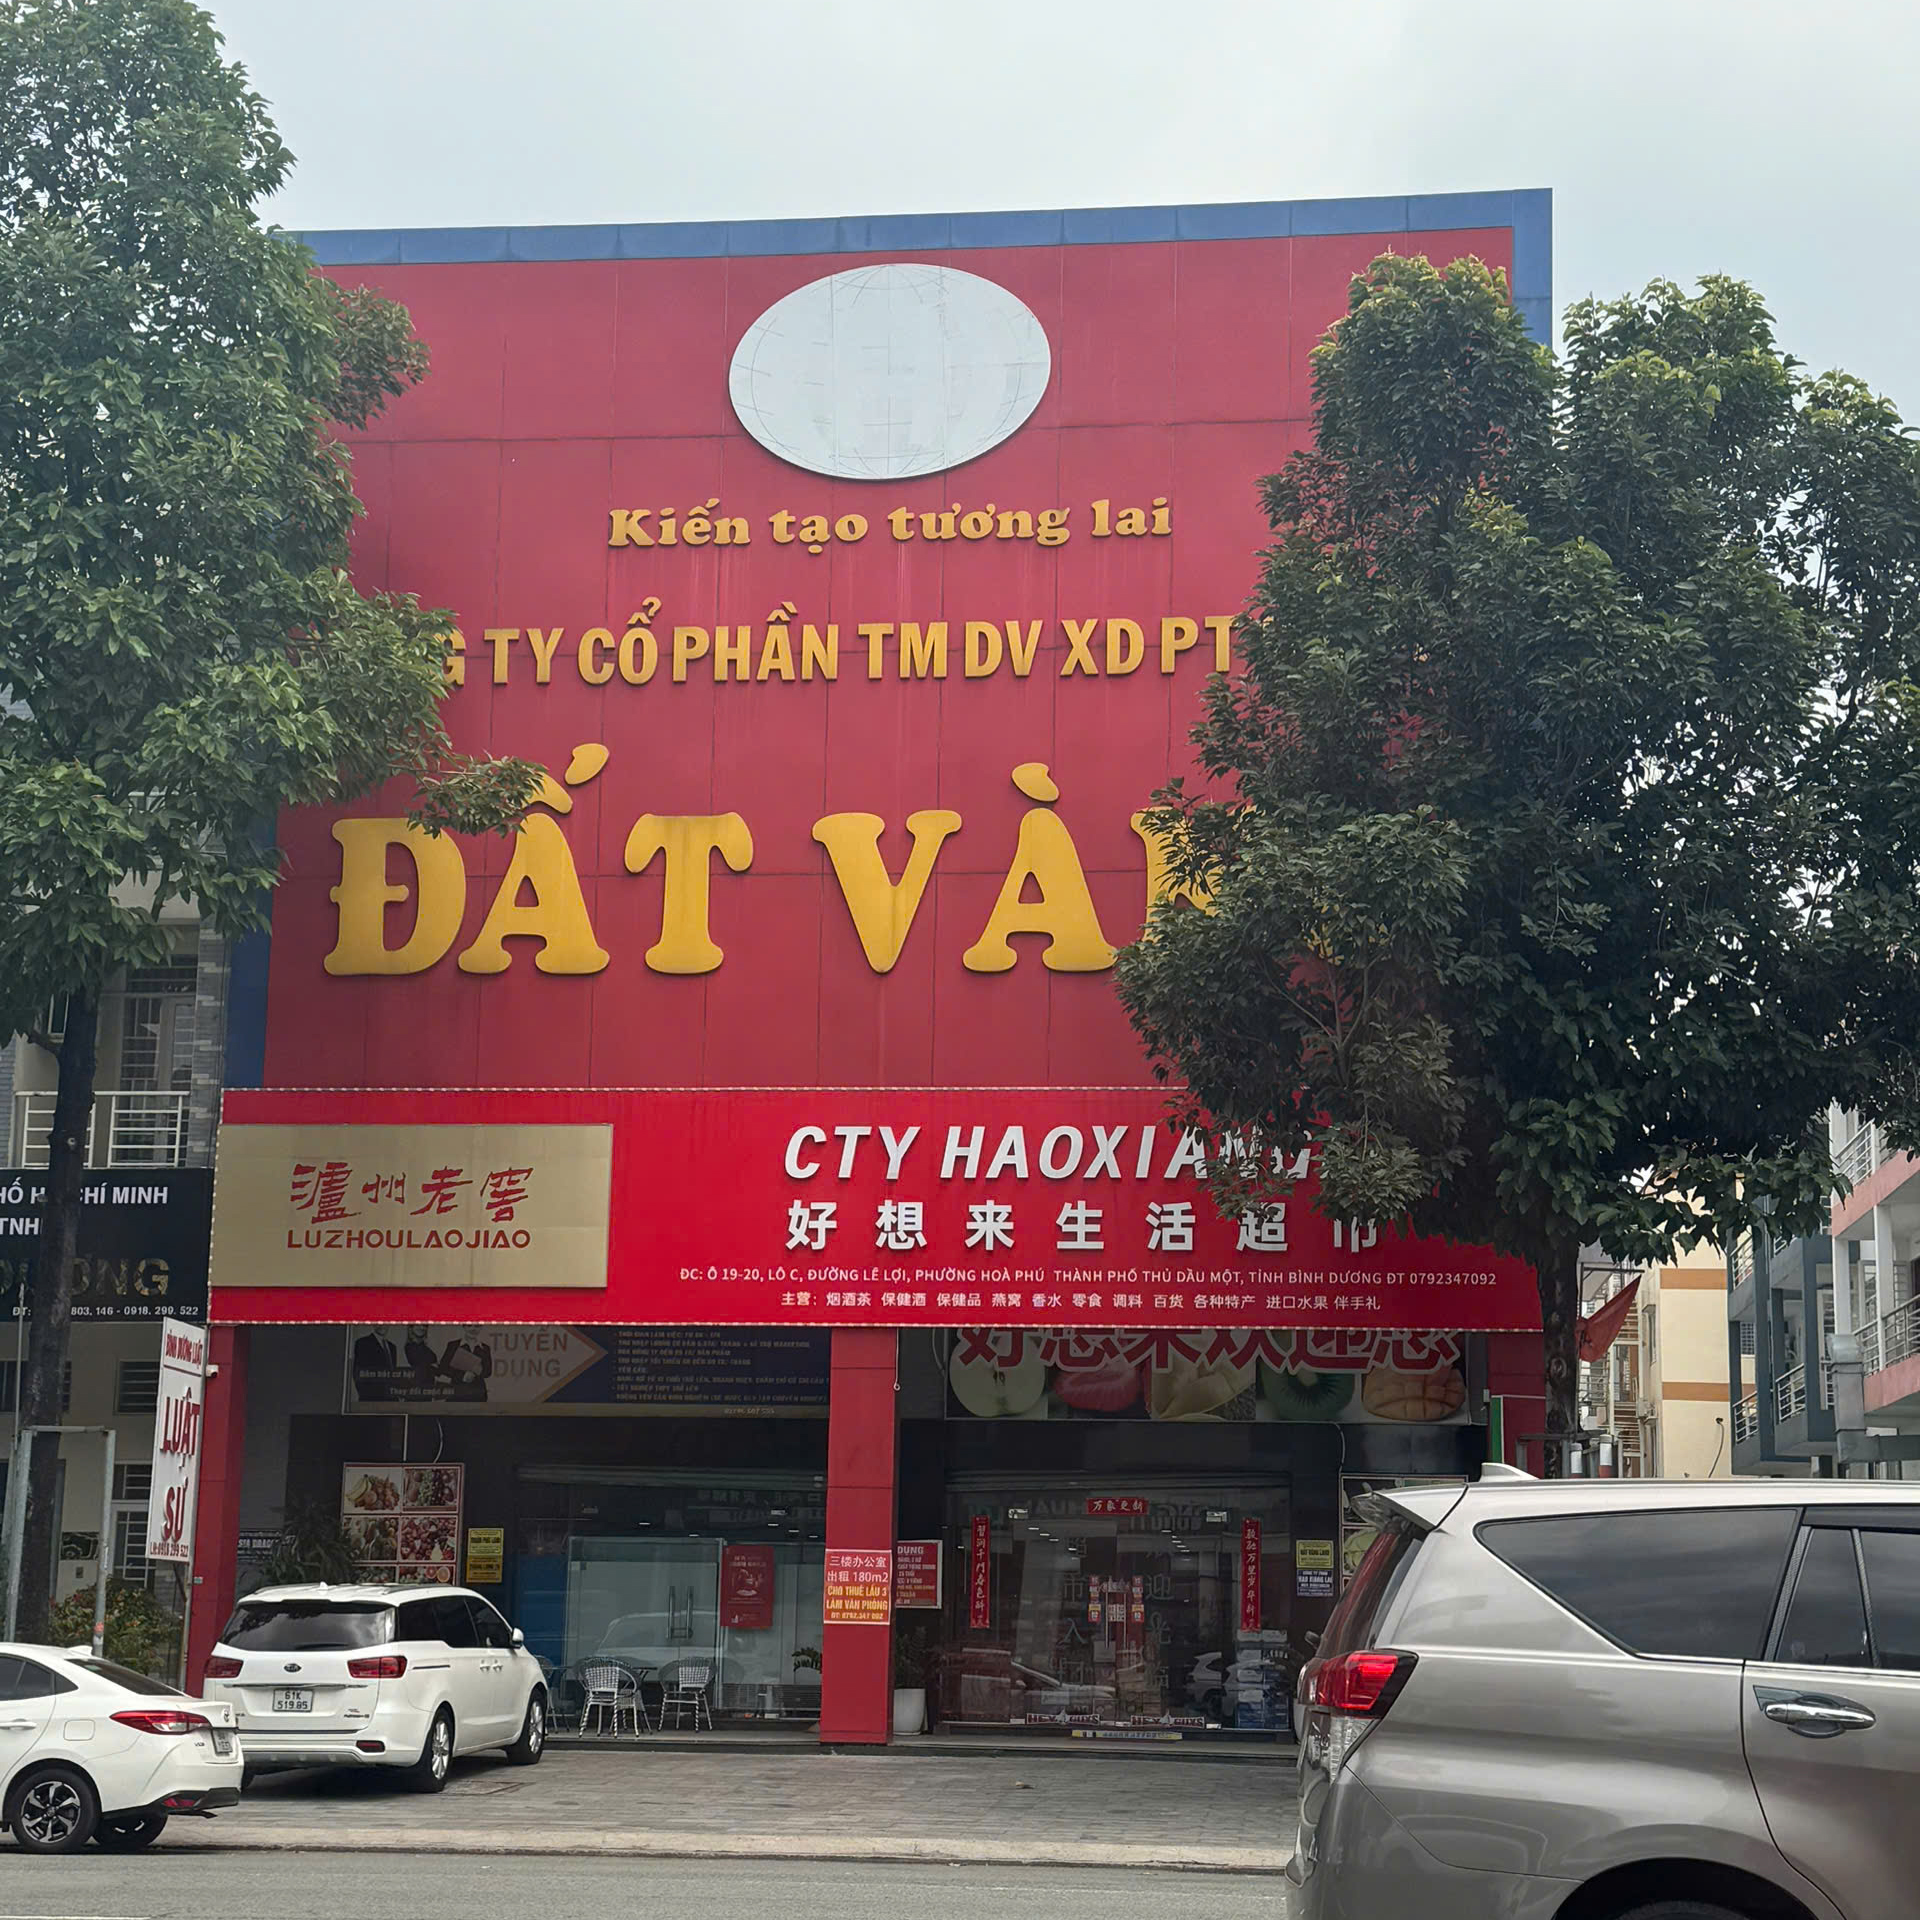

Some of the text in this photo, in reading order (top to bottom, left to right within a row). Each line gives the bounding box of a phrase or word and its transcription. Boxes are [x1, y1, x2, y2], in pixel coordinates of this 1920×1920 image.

[608, 497, 1172, 553] Kiến tạo tương lai
[484, 627, 564, 684] TY
[577, 596, 662, 685] CỔ
[672, 602, 838, 683] PHẦN
[858, 620, 948, 680] TM
[965, 618, 1044, 677] DV
[1060, 617, 1145, 676] XD
[323, 742, 754, 976] ĐẤT
[784, 1124, 921, 1182] CTY
[112, 1186, 168, 1204] MINH
[0, 1217, 43, 1235] TNH
[287, 1229, 531, 1249] LUZHOULAOJIAO
[722, 1268, 764, 1283] 19-20,
[768, 1266, 786, 1281] LÔ
[789, 1268, 803, 1283] C,
[807, 1266, 859, 1281] ĐƯỜNG
[883, 1268, 911, 1284] LỢI,
[915, 1266, 976, 1282] PHƯỜNG
[981, 1266, 1011, 1282] HOÀ
[1015, 1267, 1045, 1282] PHÚ
[1054, 1267, 1103, 1283] THÀNH
[1107, 1267, 1138, 1283] PHỐ
[1142, 1267, 1172, 1283] THỦ
[1176, 1267, 1206, 1283] DẦU
[1210, 1269, 1245, 1286] MỘT,
[1288, 1269, 1324, 1284] BÌNH
[1329, 1270, 1382, 1285] DƯƠNG
[1386, 1272, 1405, 1285] ĐT
[1409, 1272, 1497, 1286] 0792347092
[124, 1306, 151, 1316] 0918.
[180, 1306, 199, 1316] 522
[826, 1291, 872, 1307] 烟酒茶
[881, 1292, 927, 1307] 保健酒
[936, 1292, 982, 1307] 保健品
[991, 1293, 1022, 1308] 燕窝
[1032, 1293, 1063, 1308] 香水
[1072, 1293, 1103, 1308] 零食
[1112, 1294, 1143, 1308] 调料
[1154, 1294, 1184, 1309] 百货
[1193, 1294, 1256, 1309] 各种特产
[1266, 1295, 1329, 1311] 进口水果
[1333, 1295, 1381, 1311] 伴手礼
[160, 1387, 200, 1468] LUẬT
[162, 1476, 188, 1542] SƯ
[829, 1555, 887, 1568] 三楼办公室
[827, 1570, 849, 1582] 出租
[853, 1571, 888, 1582] 180m2
[828, 1585, 842, 1596] CHO
